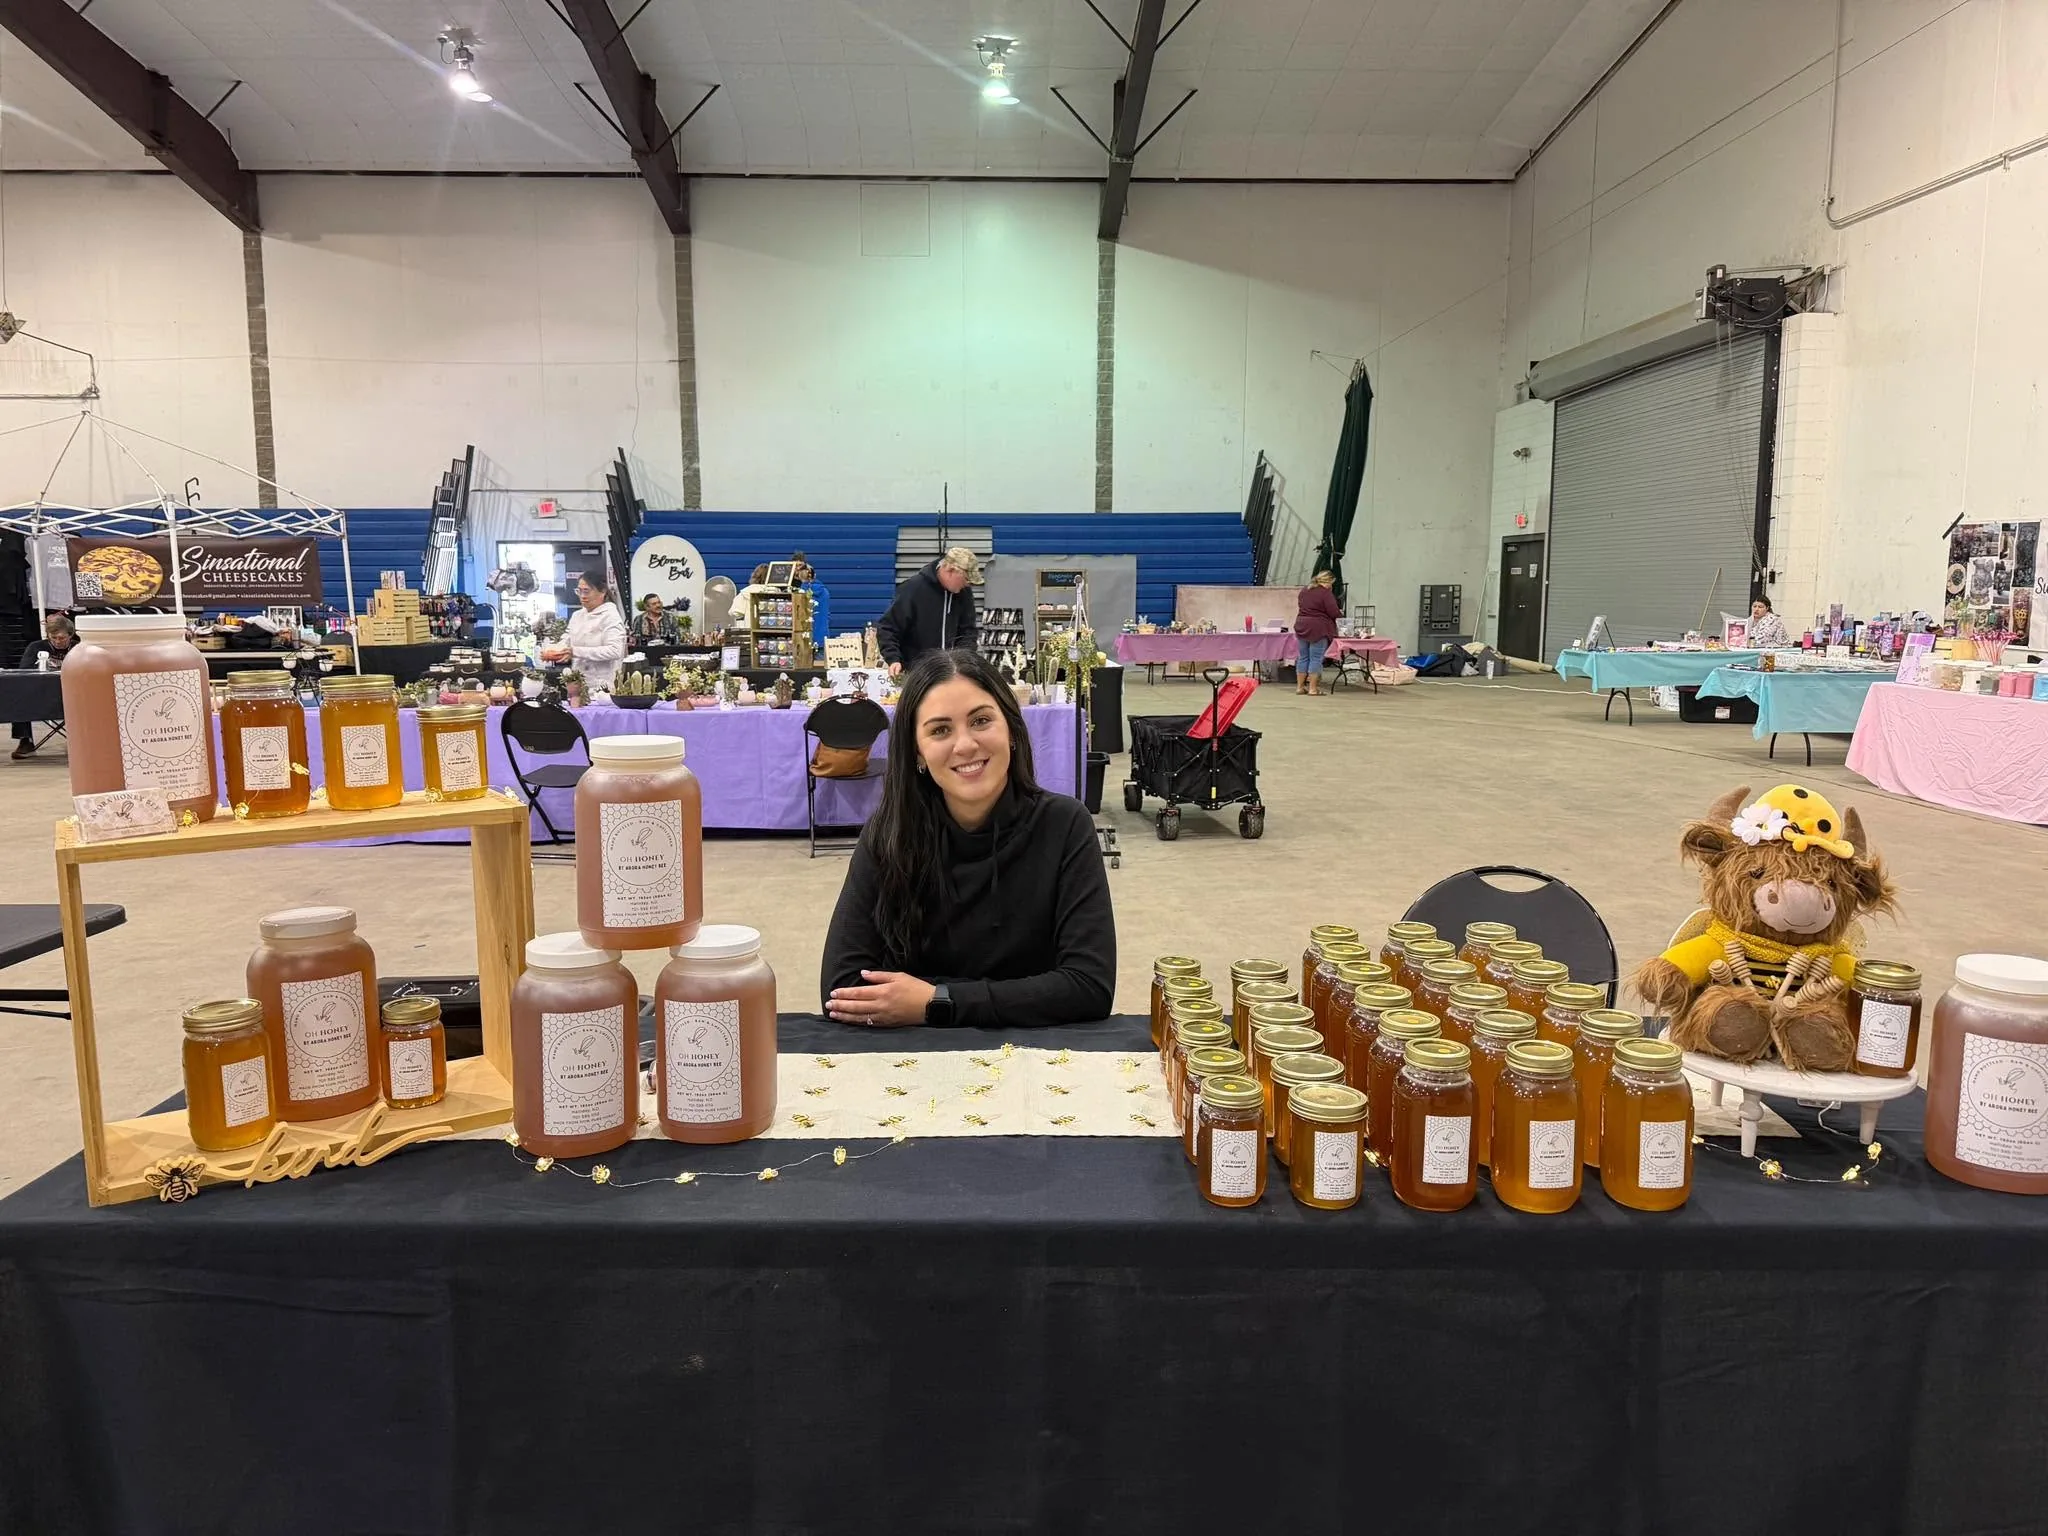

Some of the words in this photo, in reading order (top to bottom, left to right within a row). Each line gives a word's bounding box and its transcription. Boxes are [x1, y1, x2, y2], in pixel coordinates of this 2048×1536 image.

[169, 545, 310, 584] Sinsational
[647, 553, 688, 569] Bloom
[201, 571, 304, 583] CHEESECAKES
[668, 566, 694, 581] Bar
[142, 728, 157, 736] OH
[159, 725, 191, 734] HONEY
[90, 798, 113, 820] ARORA
[113, 792, 145, 802] HONEY
[635, 854, 665, 863] HONEY
[320, 1025, 348, 1036] HONEY
[691, 1052, 720, 1060] HONEY
[577, 1060, 607, 1071] HONEY
[1982, 1092, 1998, 1101] OH
[2000, 1095, 2036, 1106] HONEY
